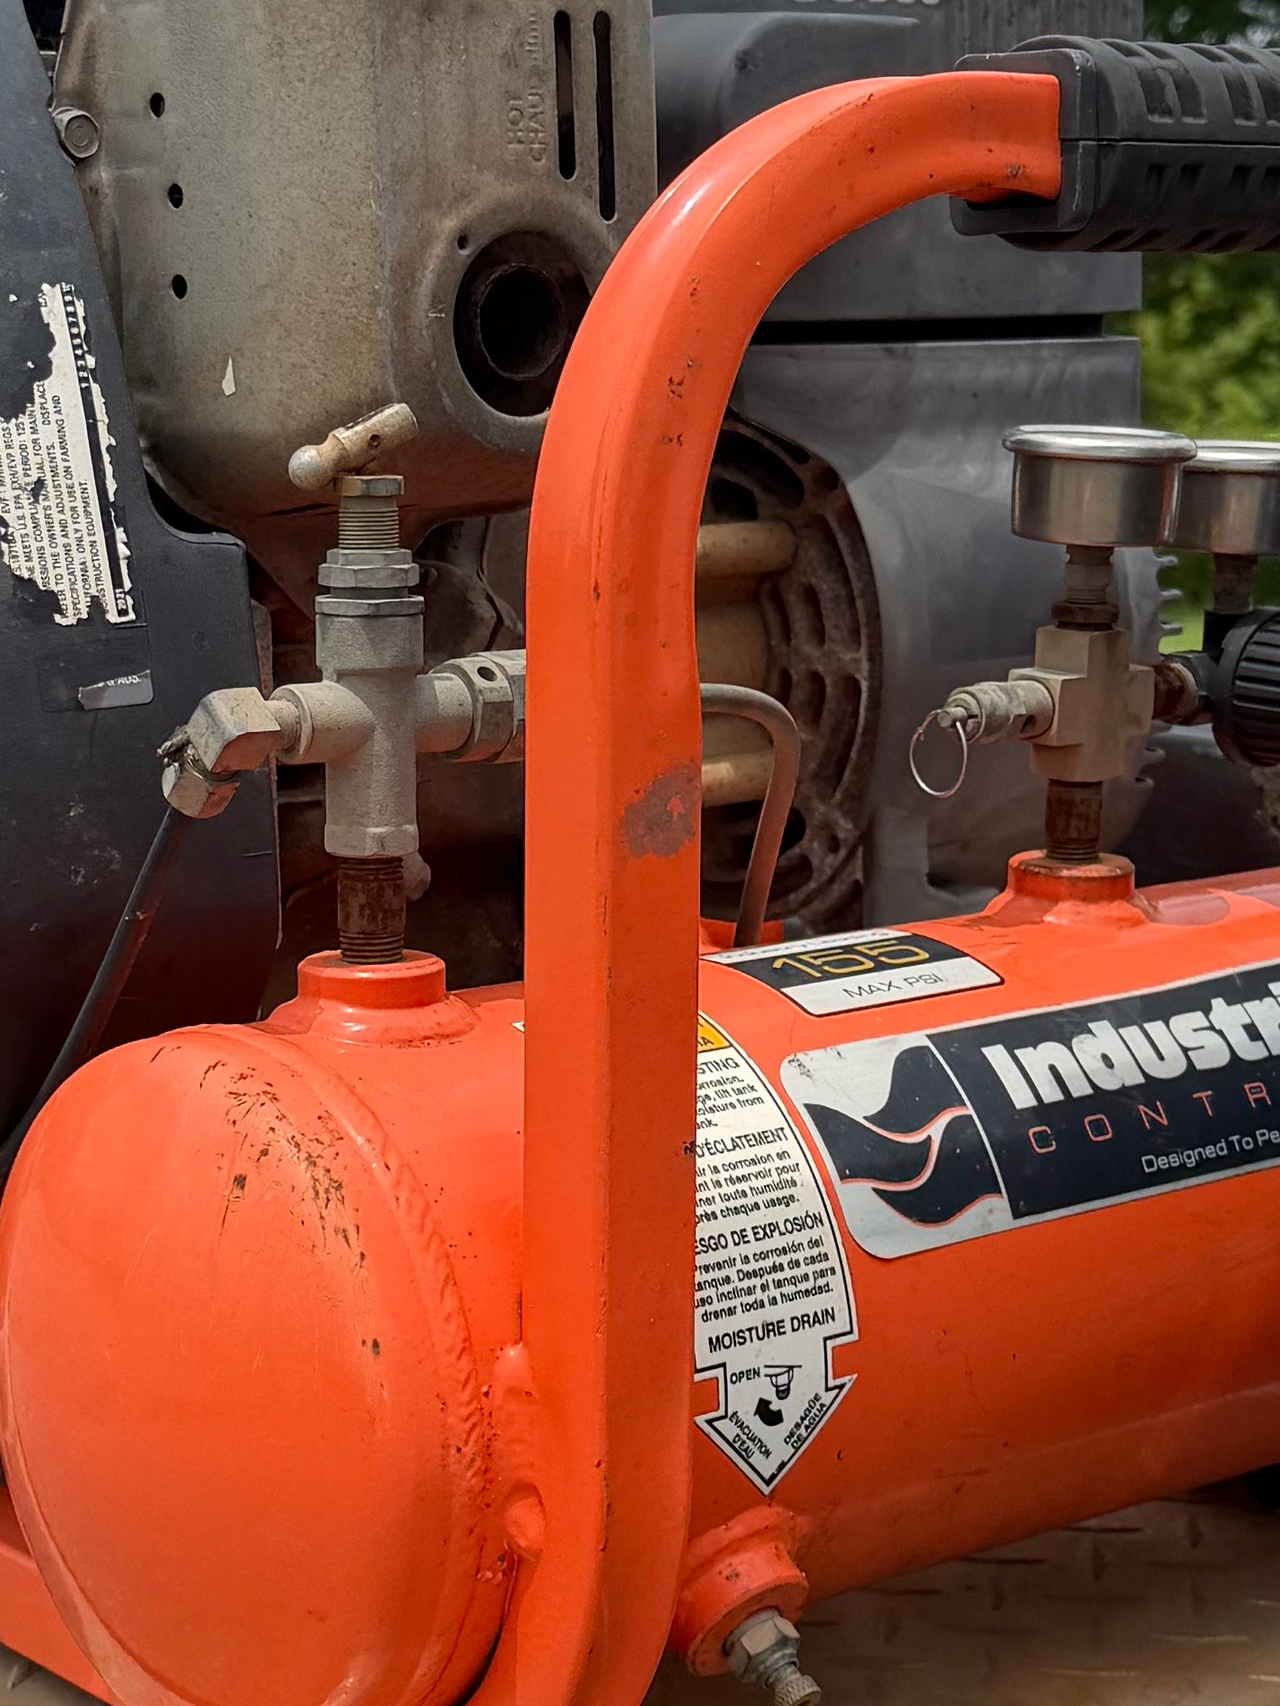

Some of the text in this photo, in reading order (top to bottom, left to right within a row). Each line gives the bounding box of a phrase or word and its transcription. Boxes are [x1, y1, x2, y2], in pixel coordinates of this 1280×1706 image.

[51, 394, 62, 415] AND
[31, 437, 42, 456] FOR
[56, 418, 70, 462] FARMING
[62, 465, 72, 480] ON
[13, 493, 23, 509] EPA
[66, 481, 77, 502] USE
[43, 504, 57, 548] OWNER'S
[70, 505, 80, 524] FOR
[59, 518, 69, 539] AND
[73, 528, 85, 553] ONLY
[50, 551, 61, 569] THE
[54, 573, 64, 586] TO
[771, 939, 930, 979] 155
[842, 974, 944, 999] MAX PSI
[697, 1057, 741, 1075] STING
[731, 1083, 758, 1096] tank
[696, 1095, 765, 1116] oisture from
[696, 1118, 719, 1130] ank.
[721, 1153, 775, 1173] corrosion
[776, 1150, 791, 1162] en
[1141, 1139, 1228, 1174] Designed
[1229, 1135, 1254, 1153] To
[775, 1162, 802, 1179] pour
[718, 1188, 749, 1204] toute
[695, 1209, 719, 1225] près
[720, 1200, 762, 1219] chaque
[762, 1193, 800, 1210] usage.
[694, 1210, 825, 1256] ESGO DE EXPLOSIÓN
[739, 1253, 751, 1265] la
[752, 1240, 806, 1263] corrosión
[806, 1235, 825, 1250] del
[736, 1262, 786, 1283] Después
[787, 1257, 802, 1271] de
[803, 1251, 830, 1267] cada
[715, 1284, 758, 1303] inclinar
[771, 1272, 811, 1291] tanque
[811, 1266, 837, 1287] para
[701, 1306, 739, 1323] drenar
[740, 1298, 766, 1314] toda
[779, 1282, 834, 1304] humedad.
[708, 1306, 836, 1354] MOISTURE DRAIN
[729, 1367, 761, 1385] OPEN
[728, 1410, 773, 1460] ÉVACUATION
[790, 1402, 828, 1450] DE AGUA
[732, 1433, 756, 1460] D'EAU
